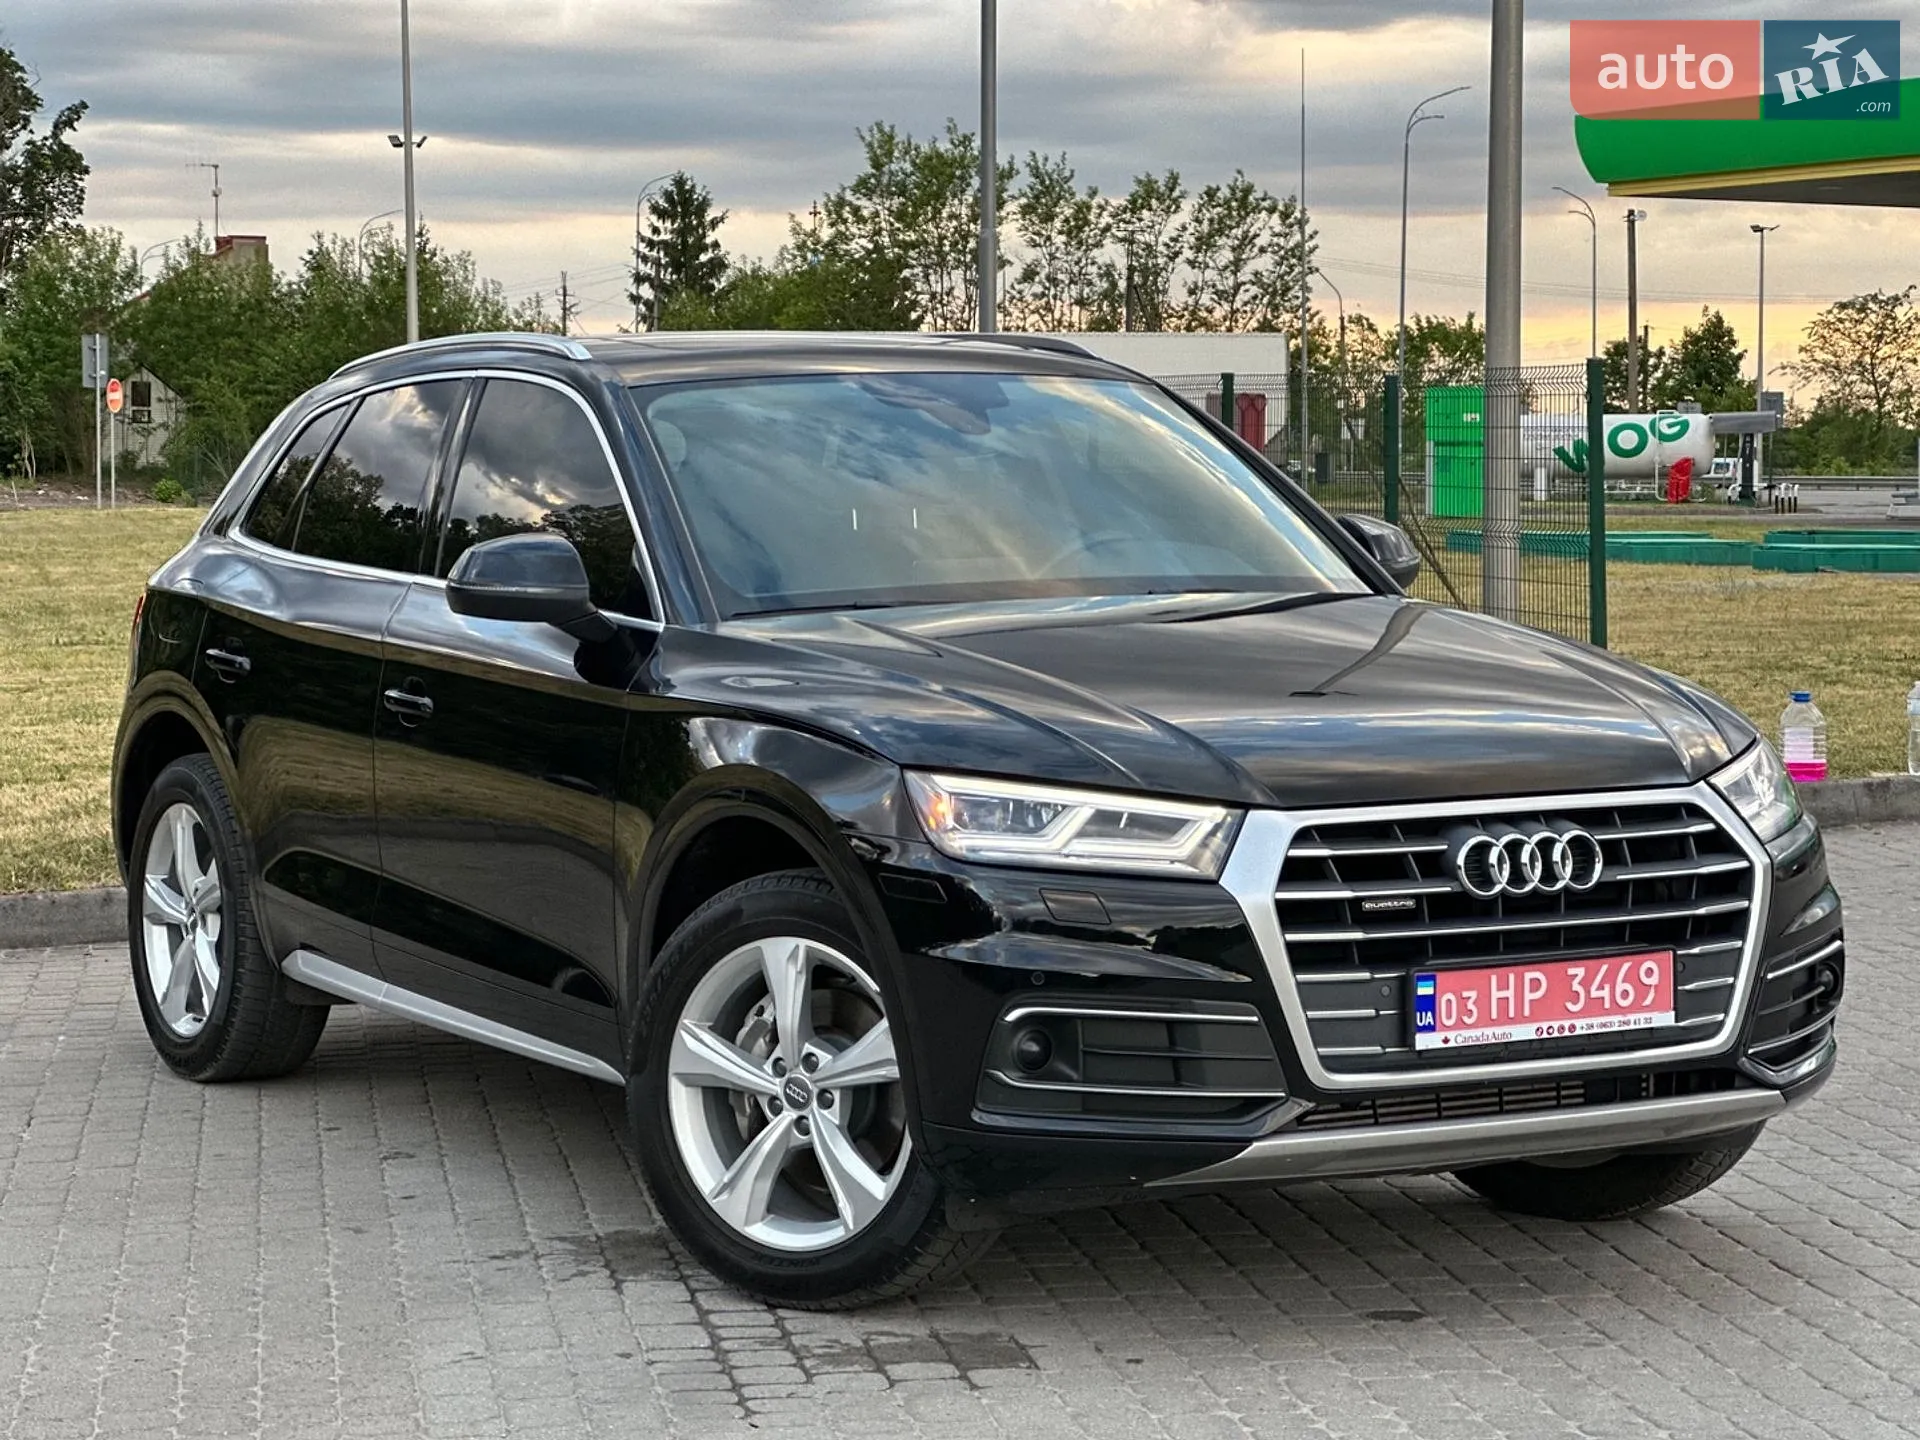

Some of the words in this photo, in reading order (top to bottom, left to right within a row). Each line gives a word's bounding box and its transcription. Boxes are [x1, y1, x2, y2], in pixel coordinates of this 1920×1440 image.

[1440, 990, 1479, 1027] 03
[1490, 971, 1548, 1020] HP
[1564, 960, 1661, 1013] 3469
[1416, 1011, 1435, 1027] UA
